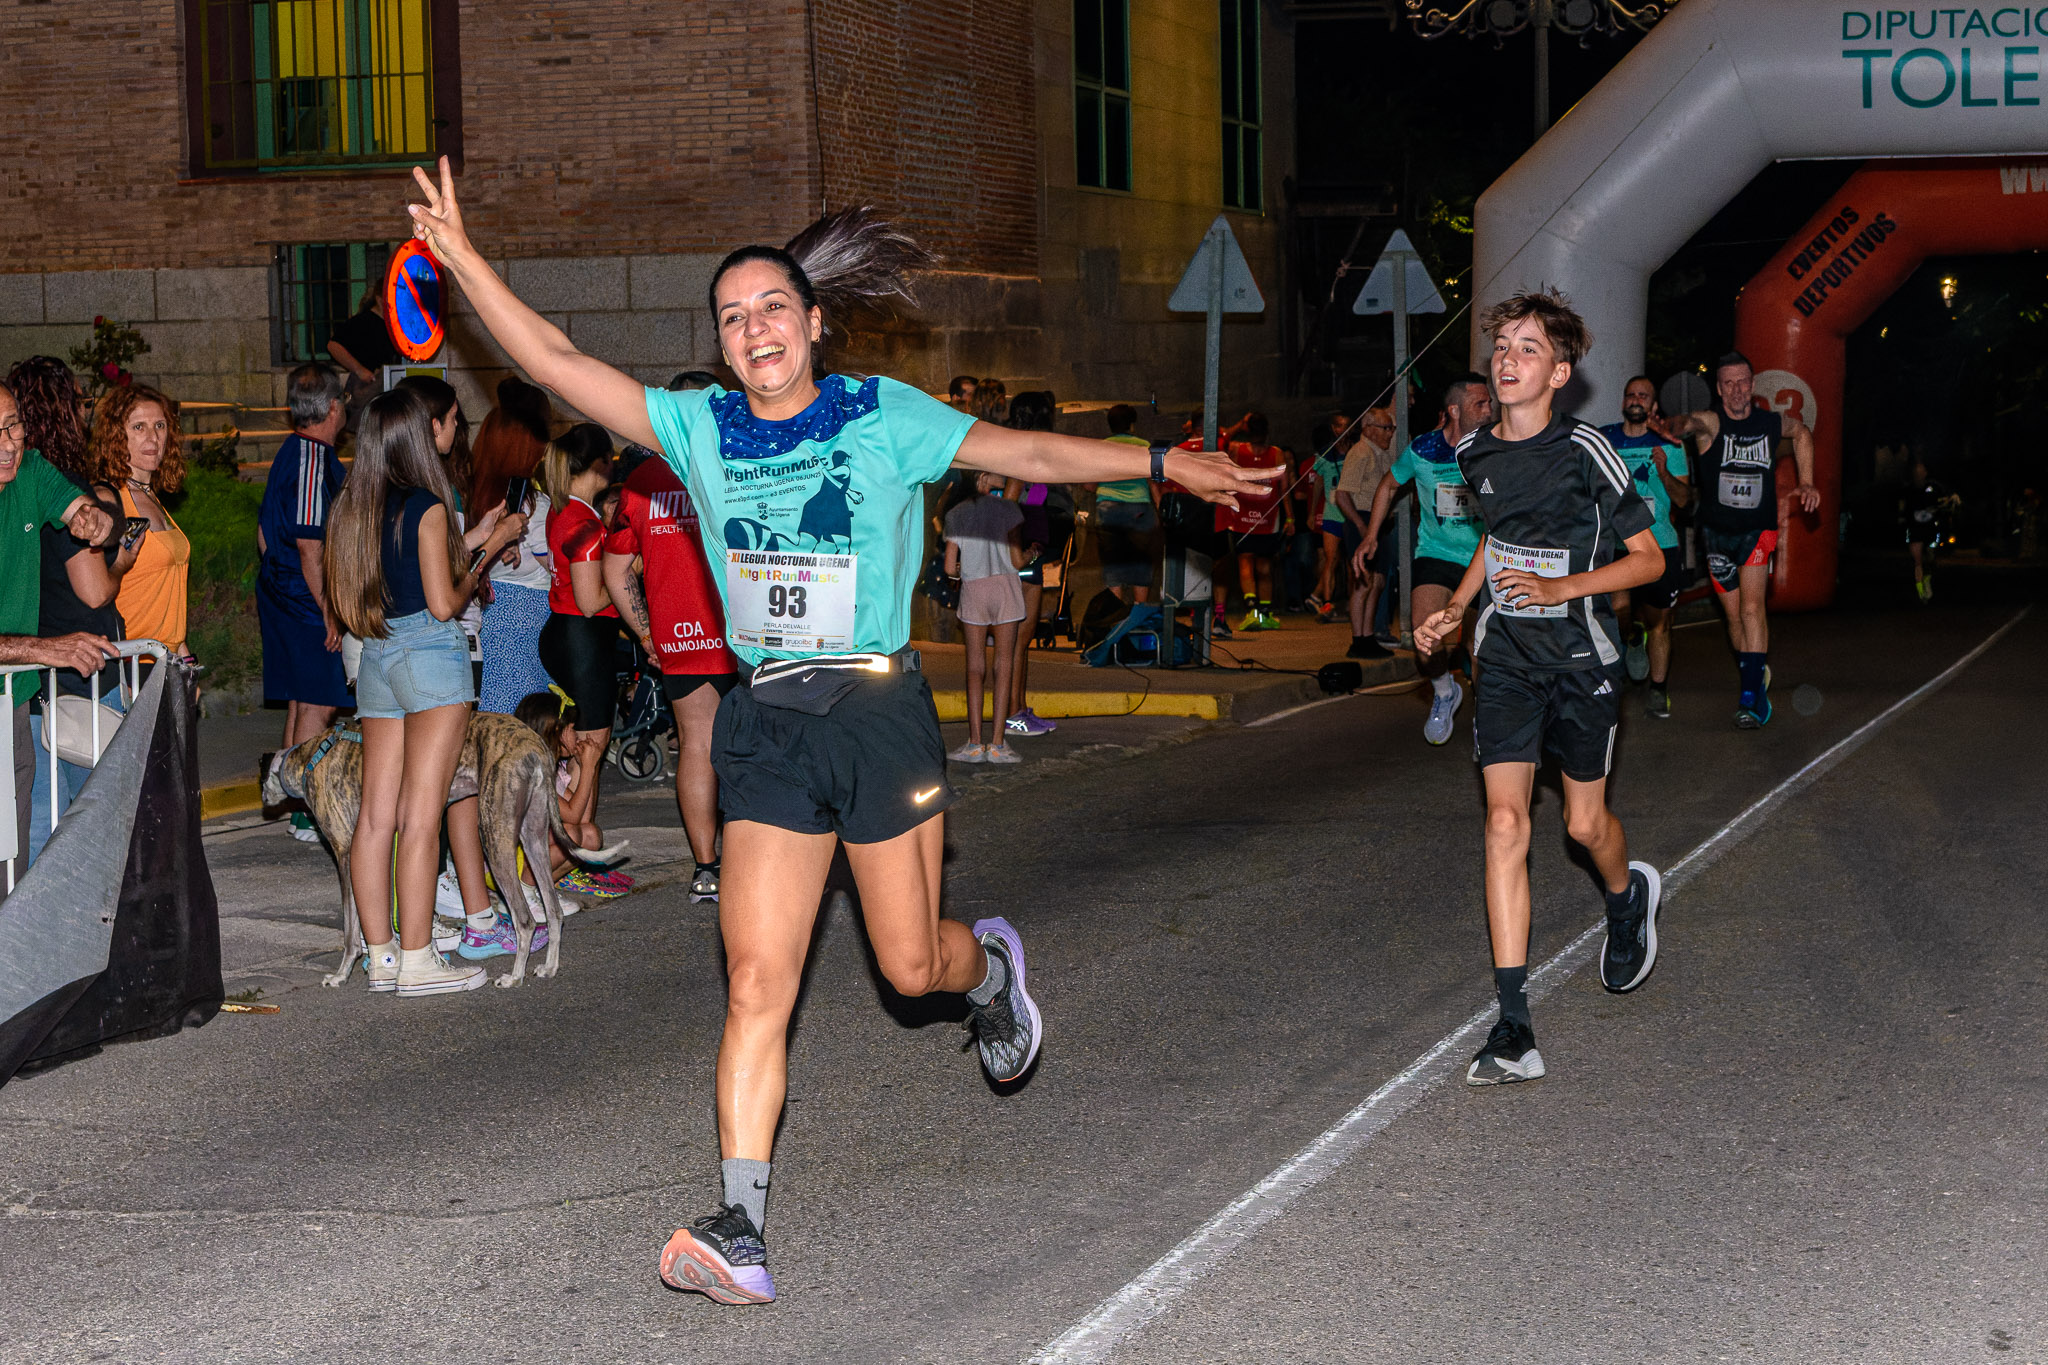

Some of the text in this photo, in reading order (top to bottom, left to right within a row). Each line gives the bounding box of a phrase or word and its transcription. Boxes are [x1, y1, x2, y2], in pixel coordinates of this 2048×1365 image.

[1842, 46, 2040, 109] TOLE
[1787, 206, 1859, 280] EVENTOS
[1793, 212, 1896, 318] DEPORTIVOS
[740, 482, 773, 491] NOCTURNA
[773, 477, 795, 487] UGENA
[778, 485, 807, 495] EVENTOS
[1731, 485, 1752, 497] 444
[1455, 496, 1469, 506] 75
[1504, 545, 1540, 558] NOCTURNA
[1541, 550, 1564, 559] UGENA
[740, 553, 766, 565] LEGUA
[767, 555, 817, 567] NOCTURNA
[819, 557, 850, 568] UGENA
[768, 584, 807, 618] 93
[673, 621, 705, 638] CDA
[660, 638, 723, 653] VALMOJADO
[440, 883, 450, 892] FILA
